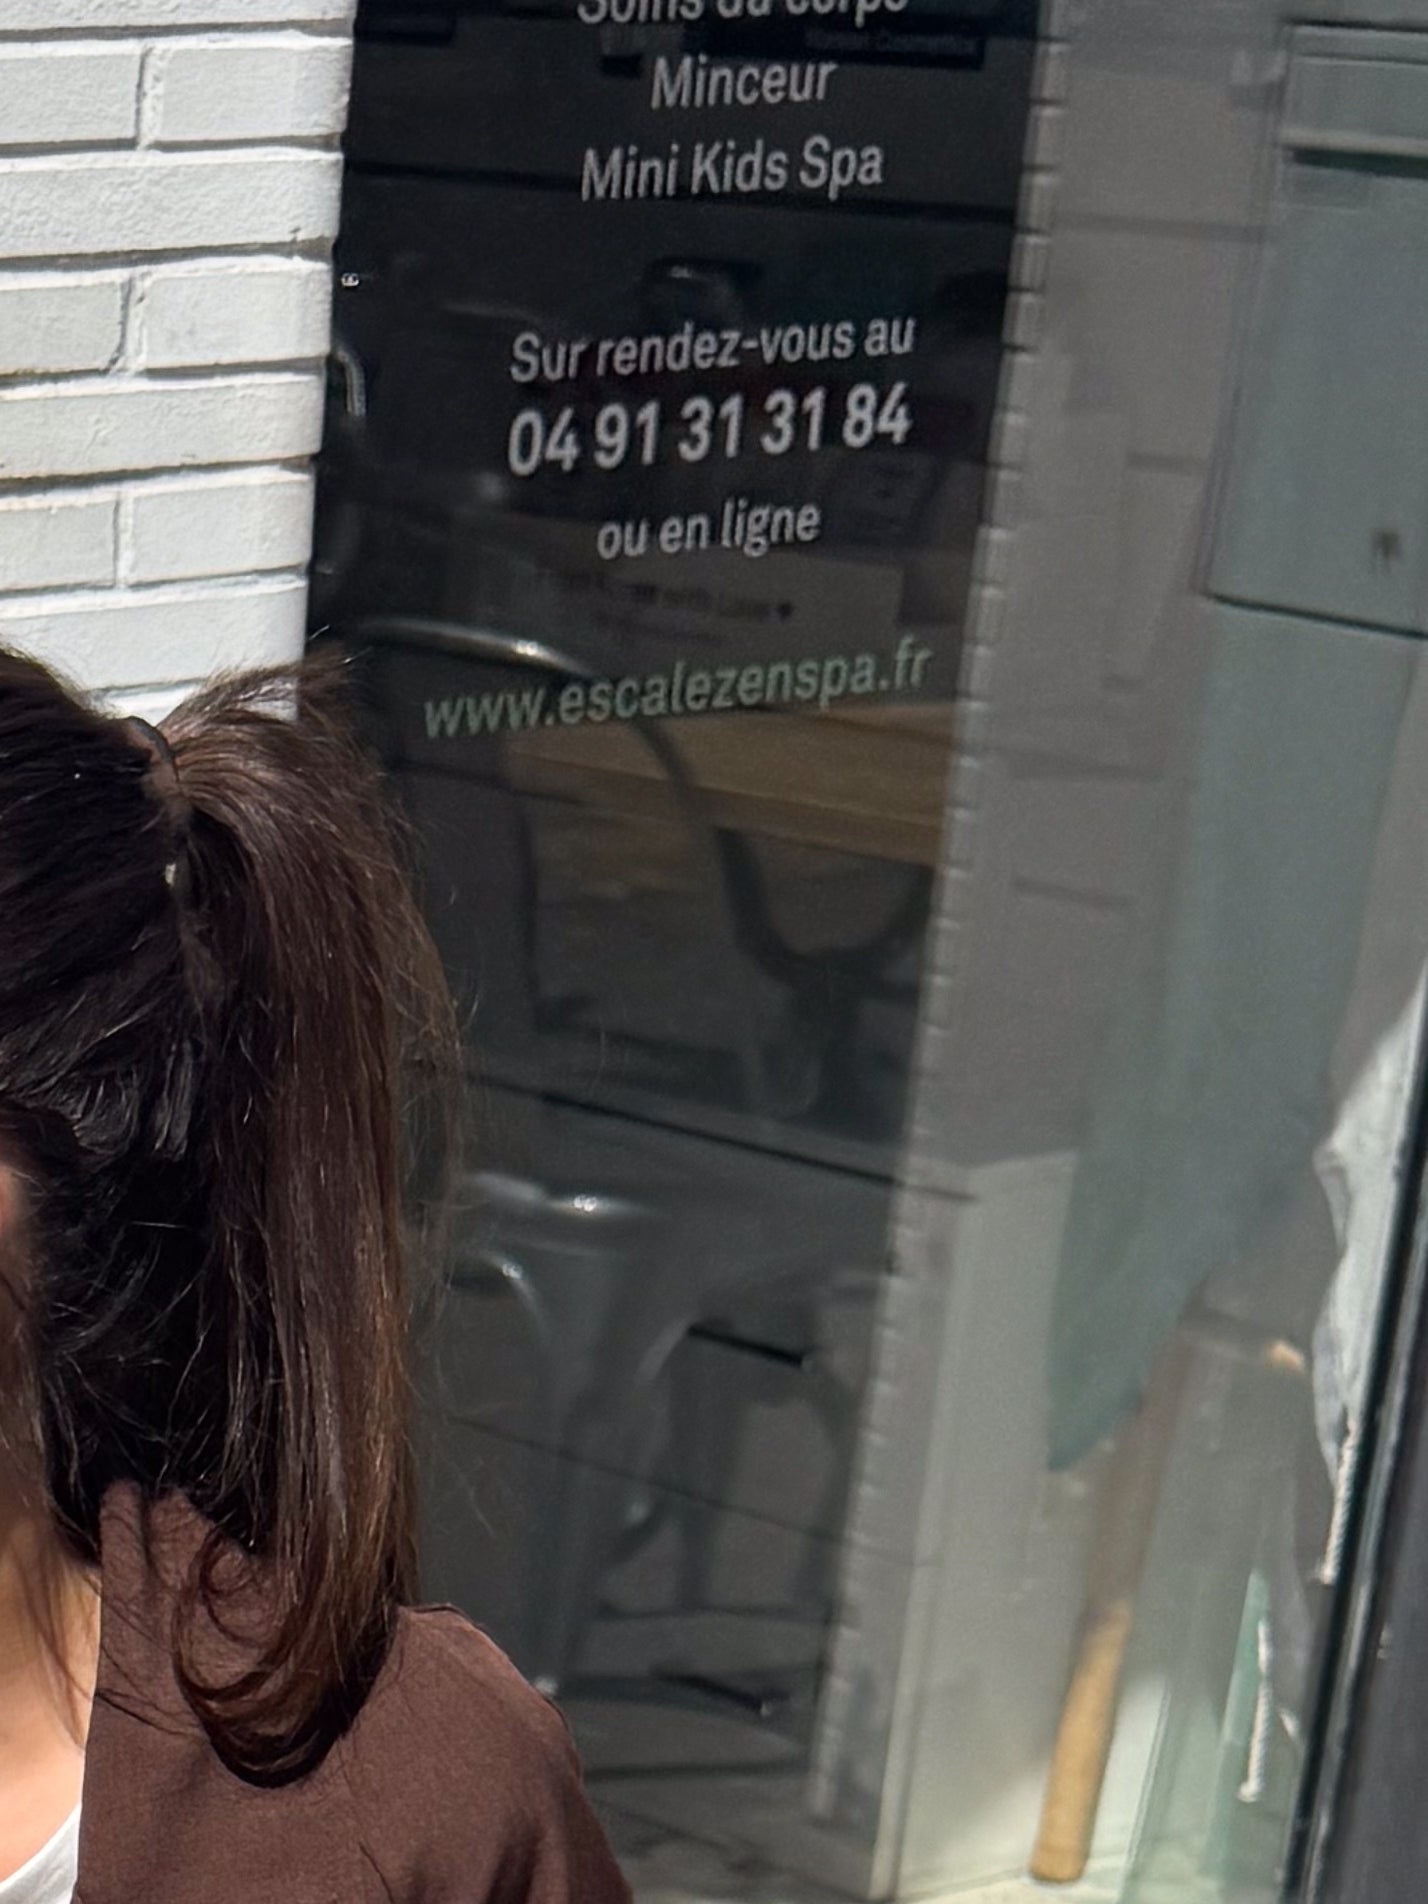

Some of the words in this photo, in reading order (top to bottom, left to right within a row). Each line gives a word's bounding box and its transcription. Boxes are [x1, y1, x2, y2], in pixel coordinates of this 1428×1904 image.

[651, 54, 839, 109] Minceur
[581, 143, 679, 201] Mini
[691, 138, 789, 193] Kids
[799, 135, 884, 200] Spa
[510, 331, 592, 382] Sur
[596, 321, 855, 377] rendez-vous
[864, 317, 916, 357] au
[508, 408, 581, 476] 04
[594, 402, 660, 468] 91
[678, 394, 744, 462] 31
[761, 387, 826, 455] 31
[843, 382, 913, 448] 84
[597, 521, 649, 560] ou
[659, 515, 710, 554] en
[721, 499, 821, 558] ligne
[425, 634, 934, 738] www.escalezenspa.fr
